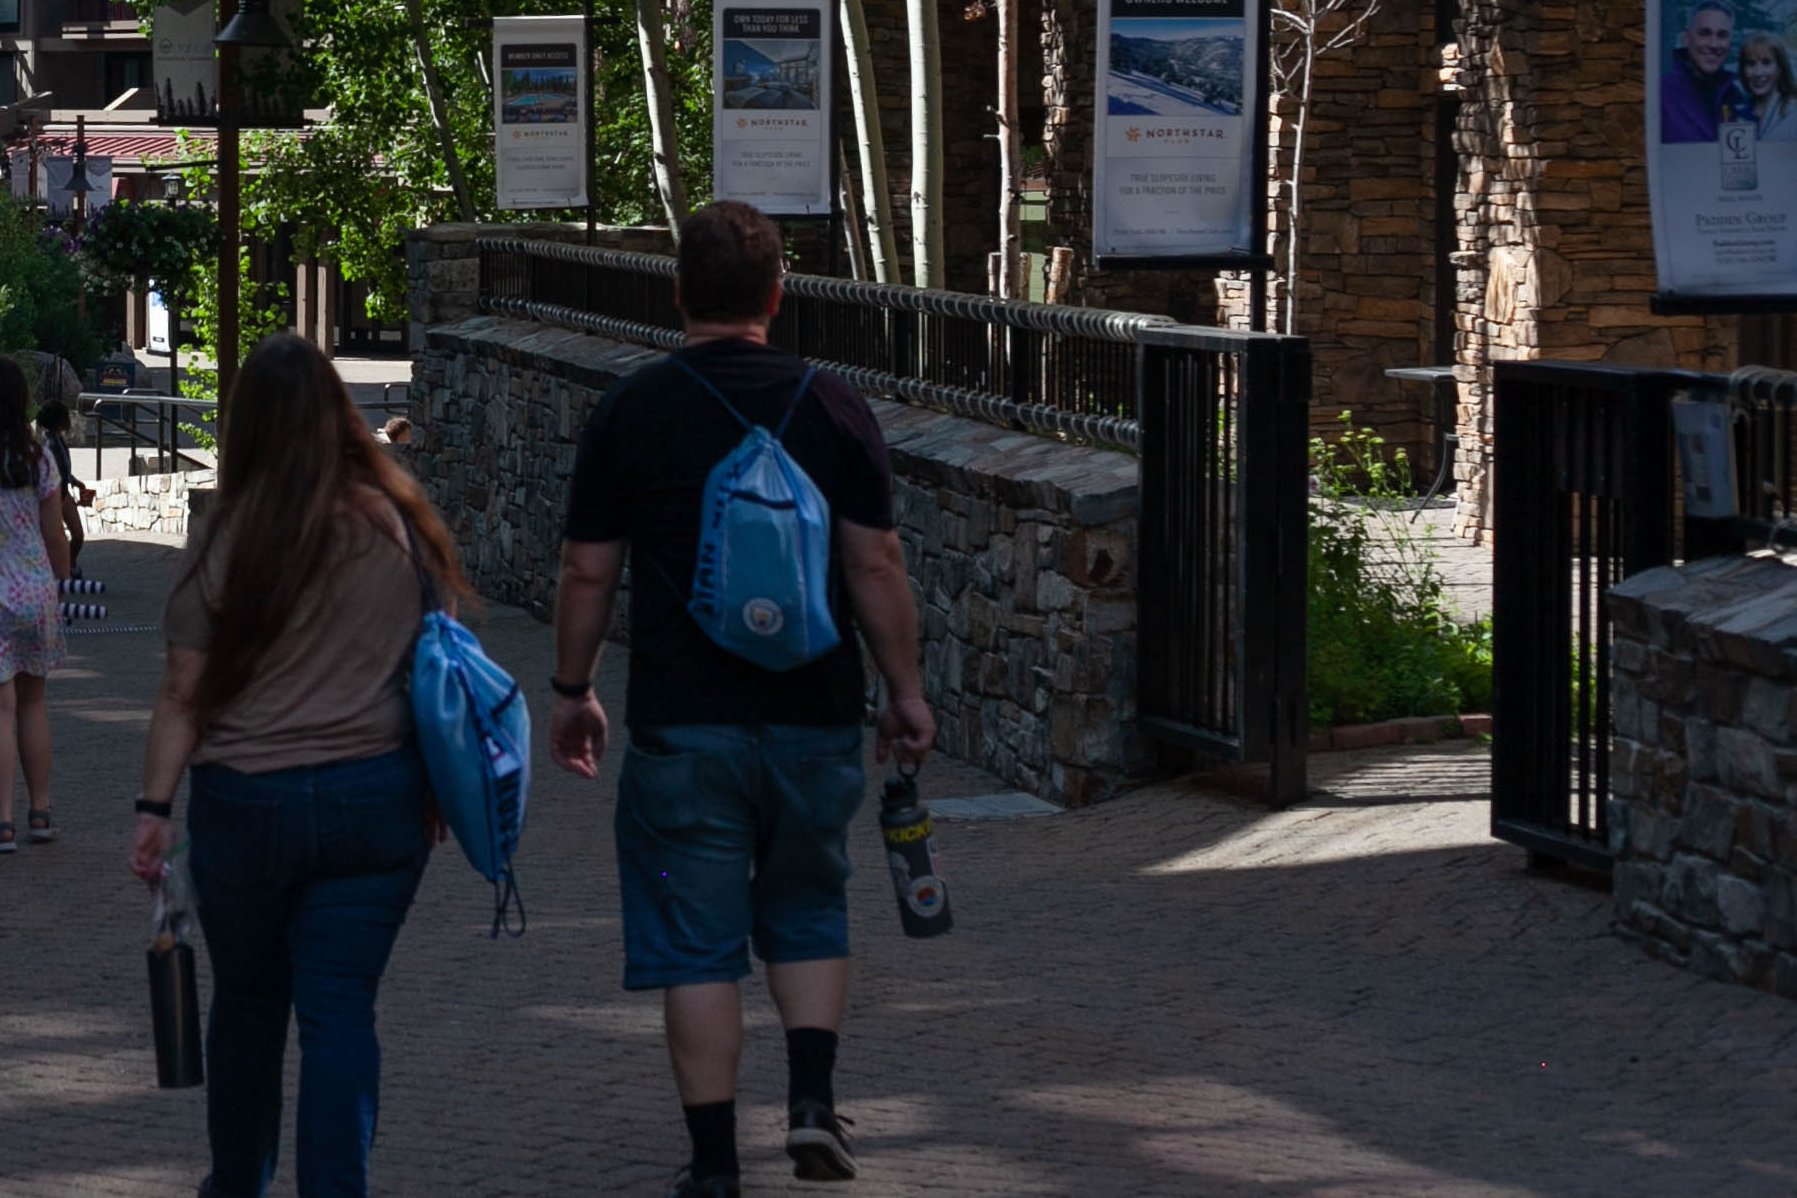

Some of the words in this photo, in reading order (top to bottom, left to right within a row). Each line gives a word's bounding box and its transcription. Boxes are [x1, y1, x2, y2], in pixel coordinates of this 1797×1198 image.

[753, 15, 774, 24] TODAY
[743, 25, 761, 33] THAN
[763, 25, 778, 33] YOU
[751, 119, 809, 127] NORTHSTAR
[1146, 128, 1225, 139] NORTHSTAR
